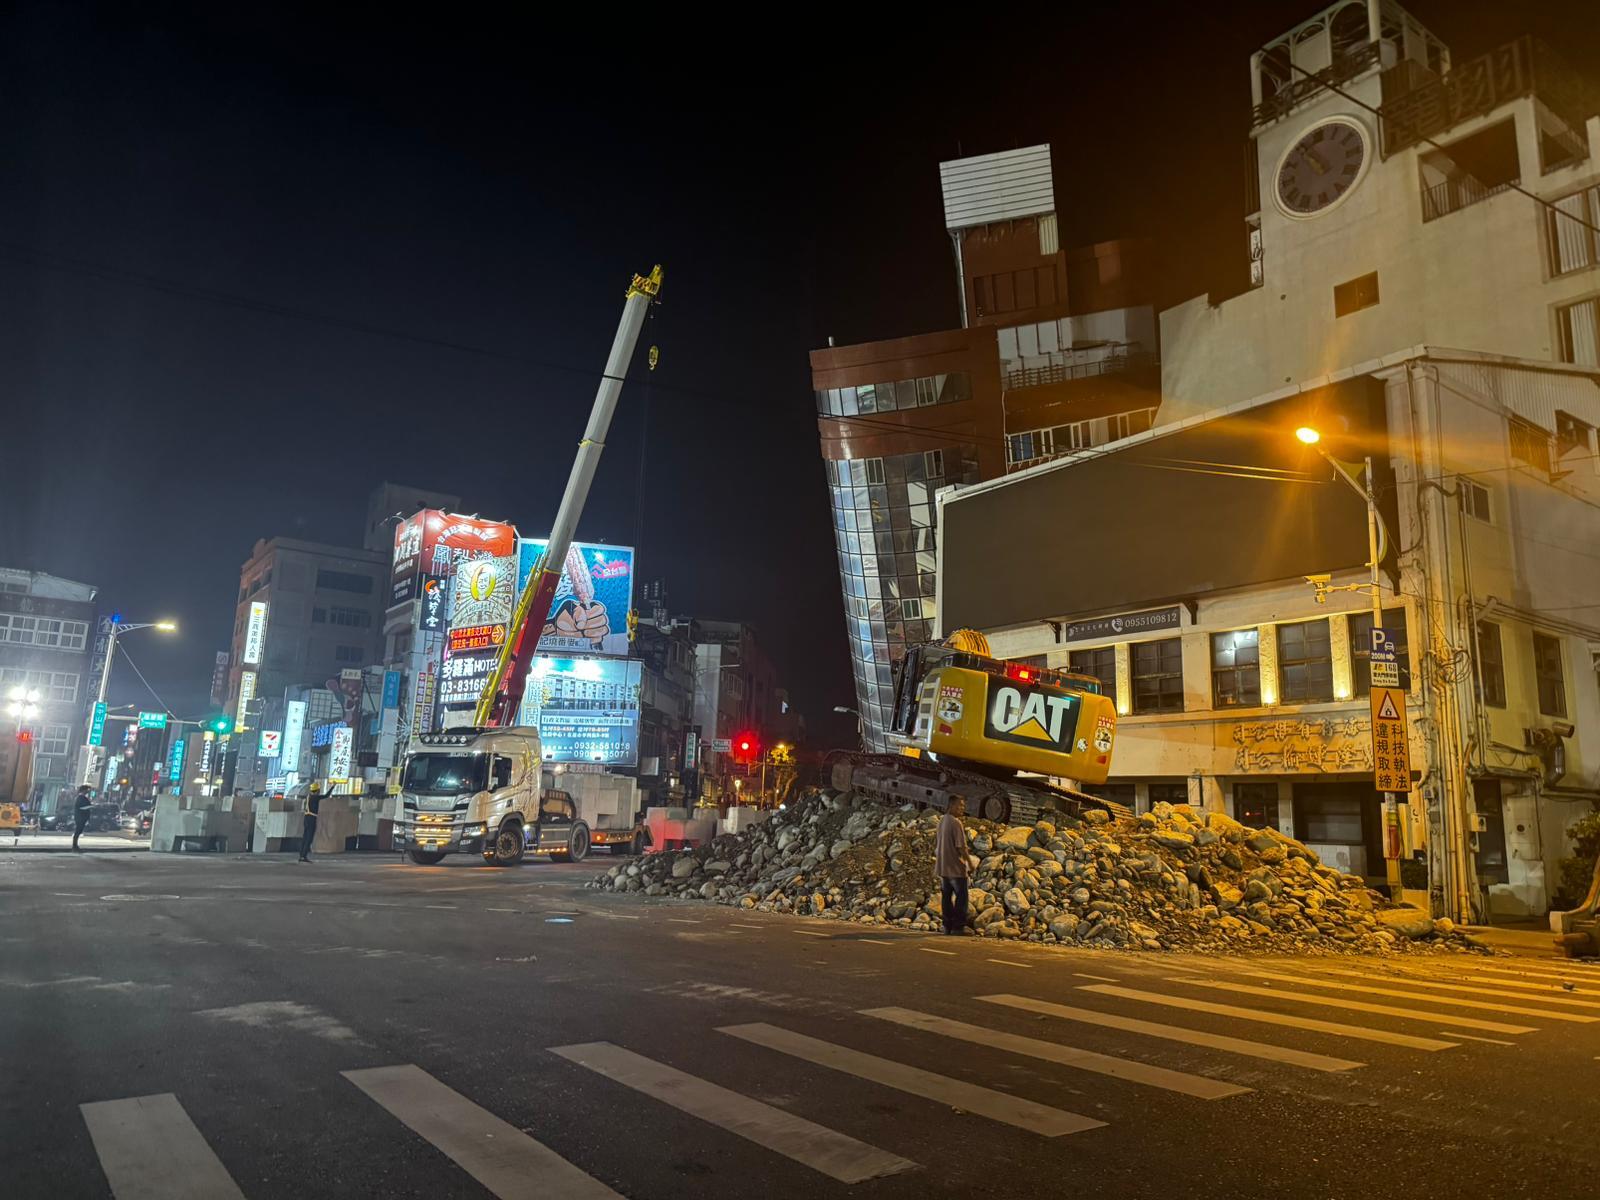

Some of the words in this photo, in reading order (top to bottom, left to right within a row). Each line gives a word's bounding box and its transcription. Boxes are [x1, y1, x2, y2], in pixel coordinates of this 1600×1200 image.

[1125, 613, 1177, 628] 0955109812
[1372, 630, 1386, 651] P
[1384, 663, 1397, 672] 168
[441, 679, 489, 694] 03-83166
[992, 687, 1070, 744] CAT
[1376, 722, 1392, 789] 違規取締
[1391, 723, 1407, 789] 科技執法
